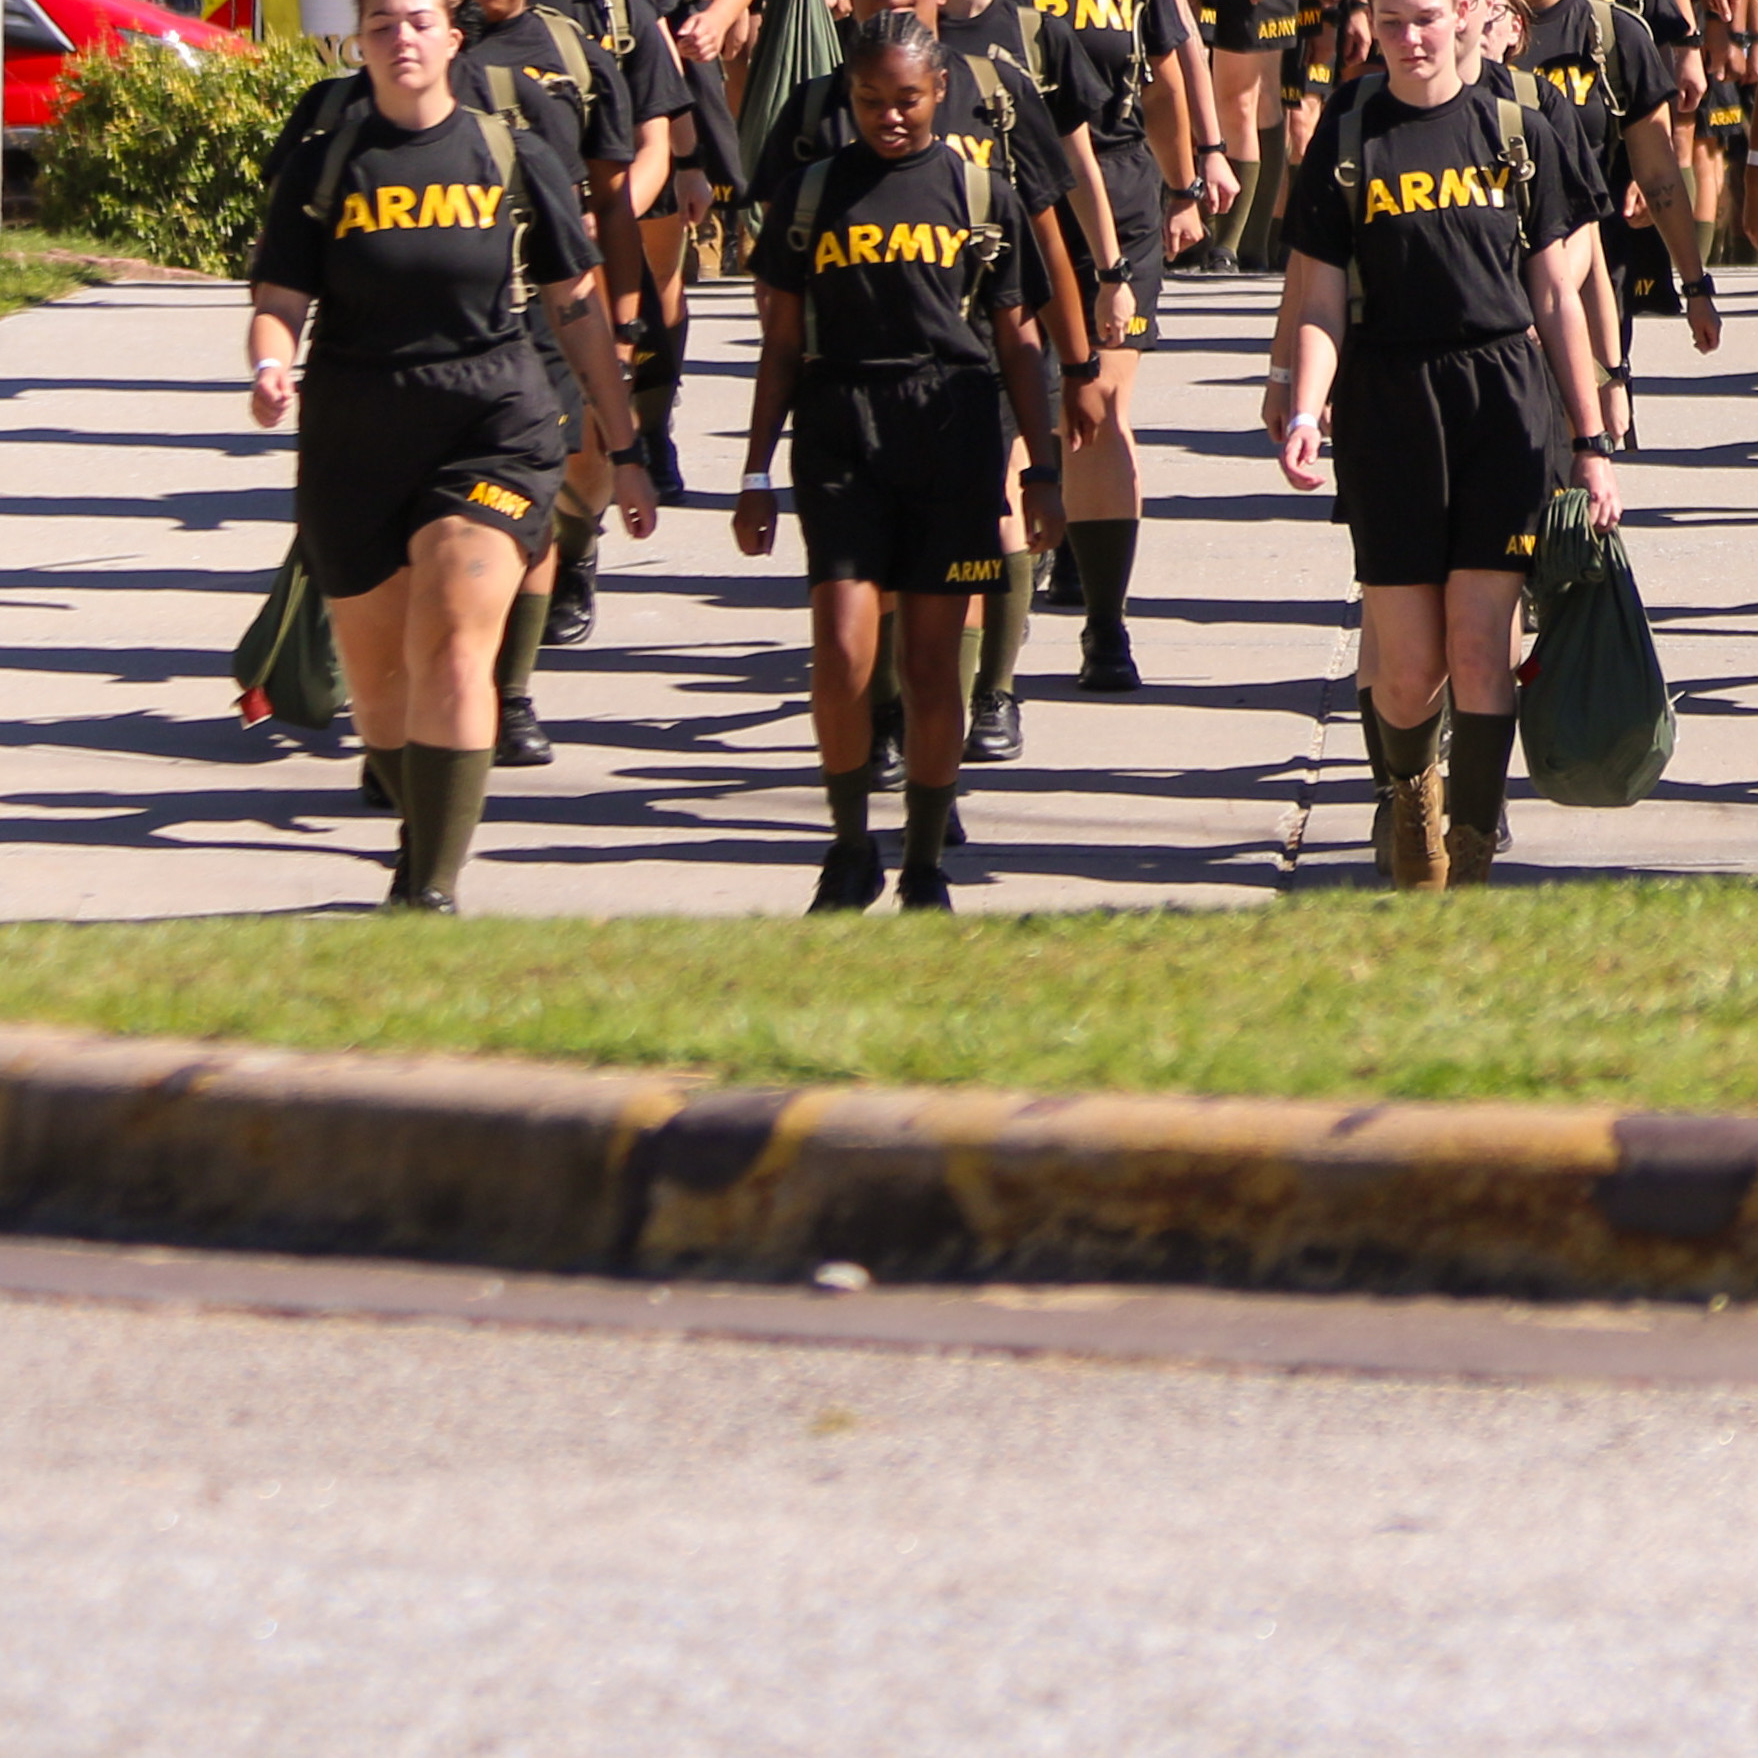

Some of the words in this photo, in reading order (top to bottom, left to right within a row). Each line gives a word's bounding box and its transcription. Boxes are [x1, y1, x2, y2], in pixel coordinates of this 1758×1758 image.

[1258, 16, 1297, 40] ARMY
[335, 184, 503, 239] ARMY
[1365, 166, 1511, 224] ARMY
[814, 222, 969, 274] ARMY
[466, 481, 533, 520] ARMY
[945, 560, 1003, 584] ARMY
